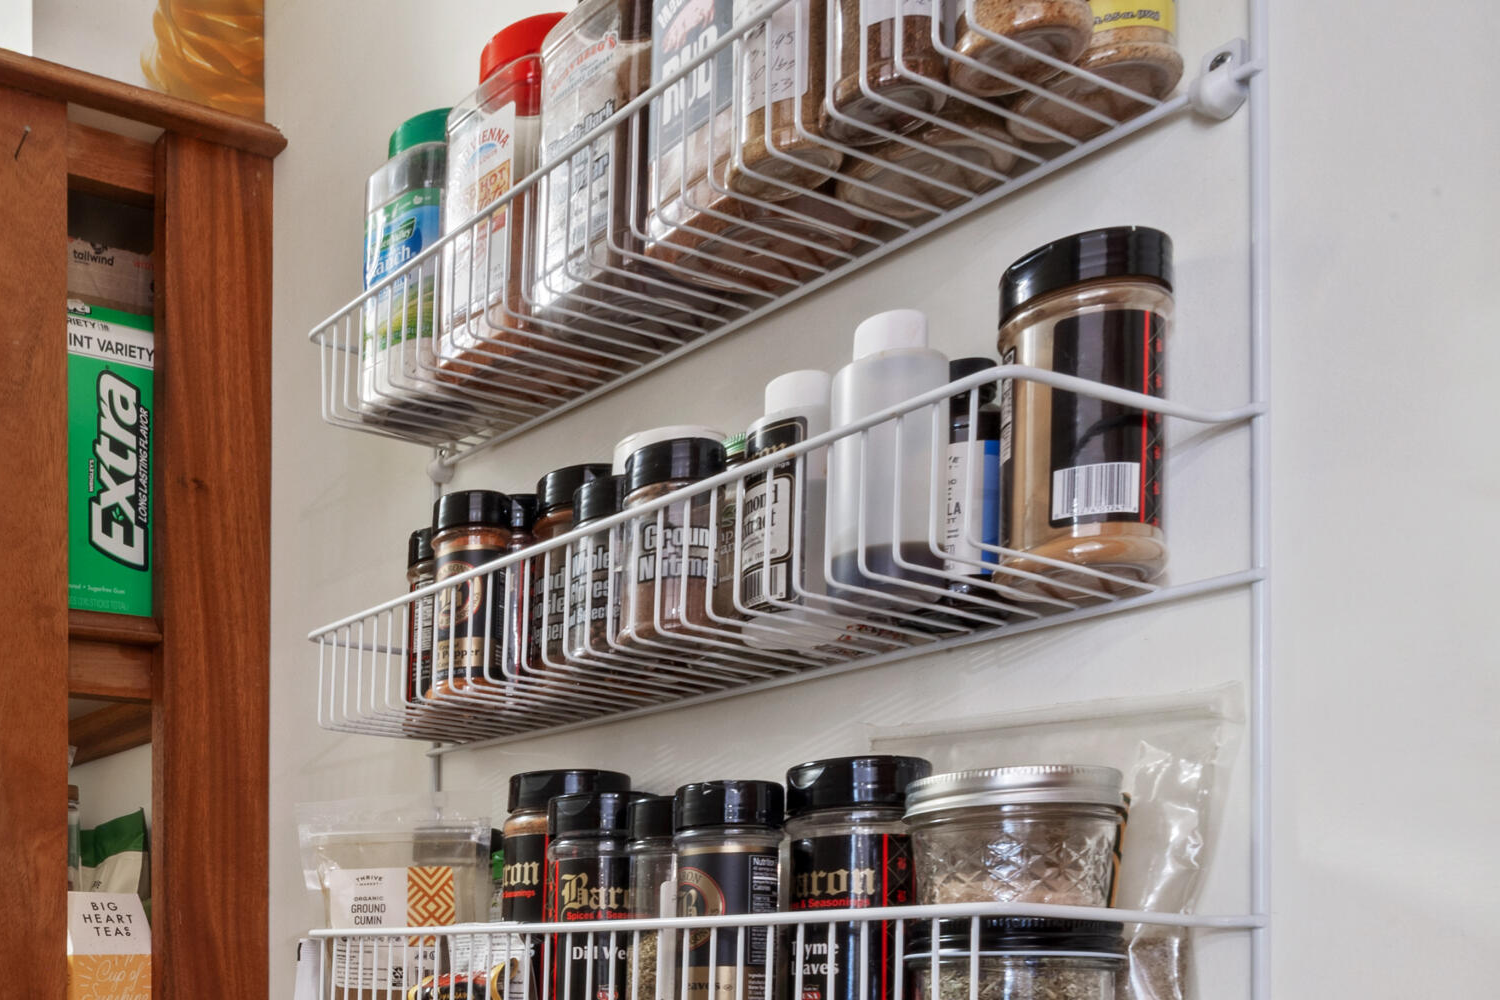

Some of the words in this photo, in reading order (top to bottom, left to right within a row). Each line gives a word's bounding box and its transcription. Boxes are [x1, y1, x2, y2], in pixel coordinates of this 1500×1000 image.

[73, 249, 115, 266] tailwind
[68, 317, 96, 328] RIETY
[69, 333, 92, 349] INT
[97, 338, 154, 361] VARIETY
[141, 407, 149, 454] FLAVOR
[90, 371, 146, 569] Extra
[139, 455, 148, 496] LASTING
[138, 497, 148, 523] LONG
[503, 861, 540, 886] ron
[796, 868, 876, 897] aron
[561, 872, 630, 910] Bar
[91, 902, 118, 911] BIG
[351, 904, 386, 914] GROUND
[808, 898, 871, 909] Seasonings
[83, 914, 133, 924] HEART
[354, 916, 382, 925] CUMIN
[566, 911, 594, 920] Spices
[94, 927, 124, 937] TEA
[791, 941, 840, 960] Tyme
[96, 960, 126, 992] Cup
[128, 962, 143, 991] of
[791, 961, 840, 976] Laves
